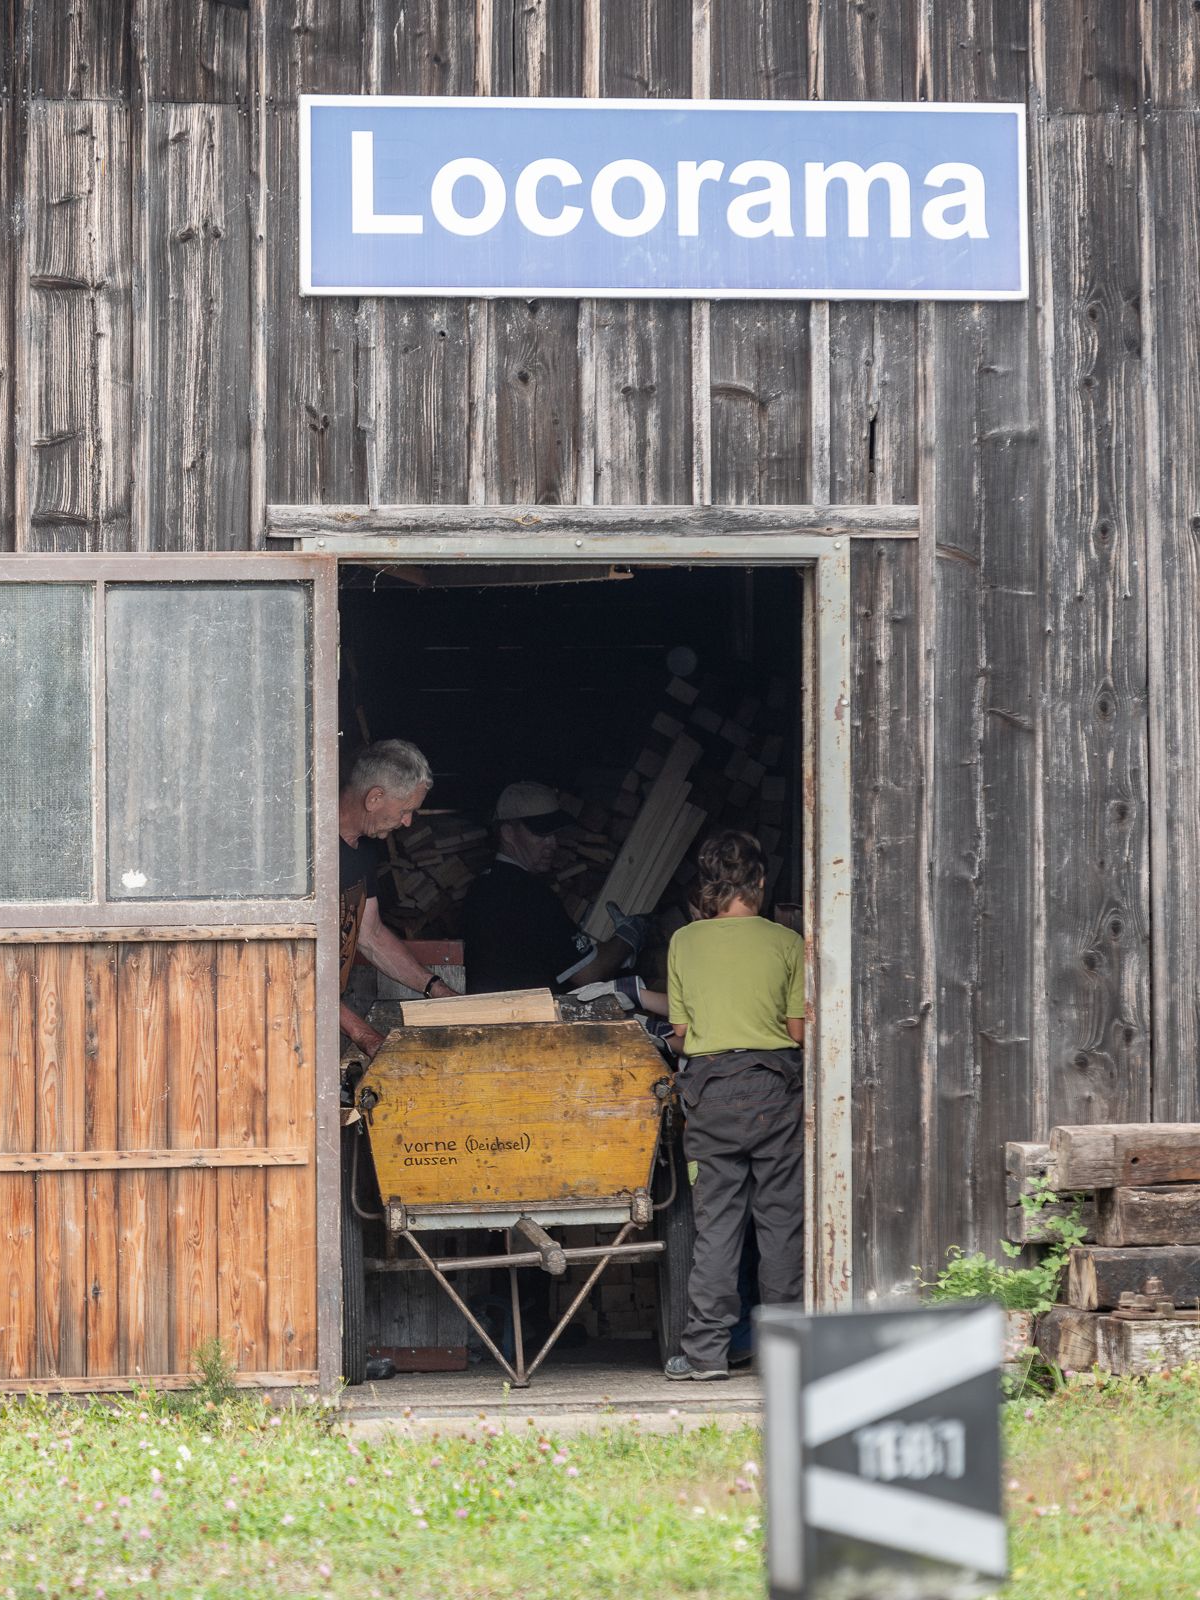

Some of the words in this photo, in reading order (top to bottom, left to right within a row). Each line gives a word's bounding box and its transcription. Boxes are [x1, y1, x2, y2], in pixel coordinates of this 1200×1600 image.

[351, 130, 990, 241] Locorama
[404, 1140, 457, 1153] vorne
[465, 1132, 531, 1153] (Deichsel)
[403, 1155, 458, 1167] aussen
